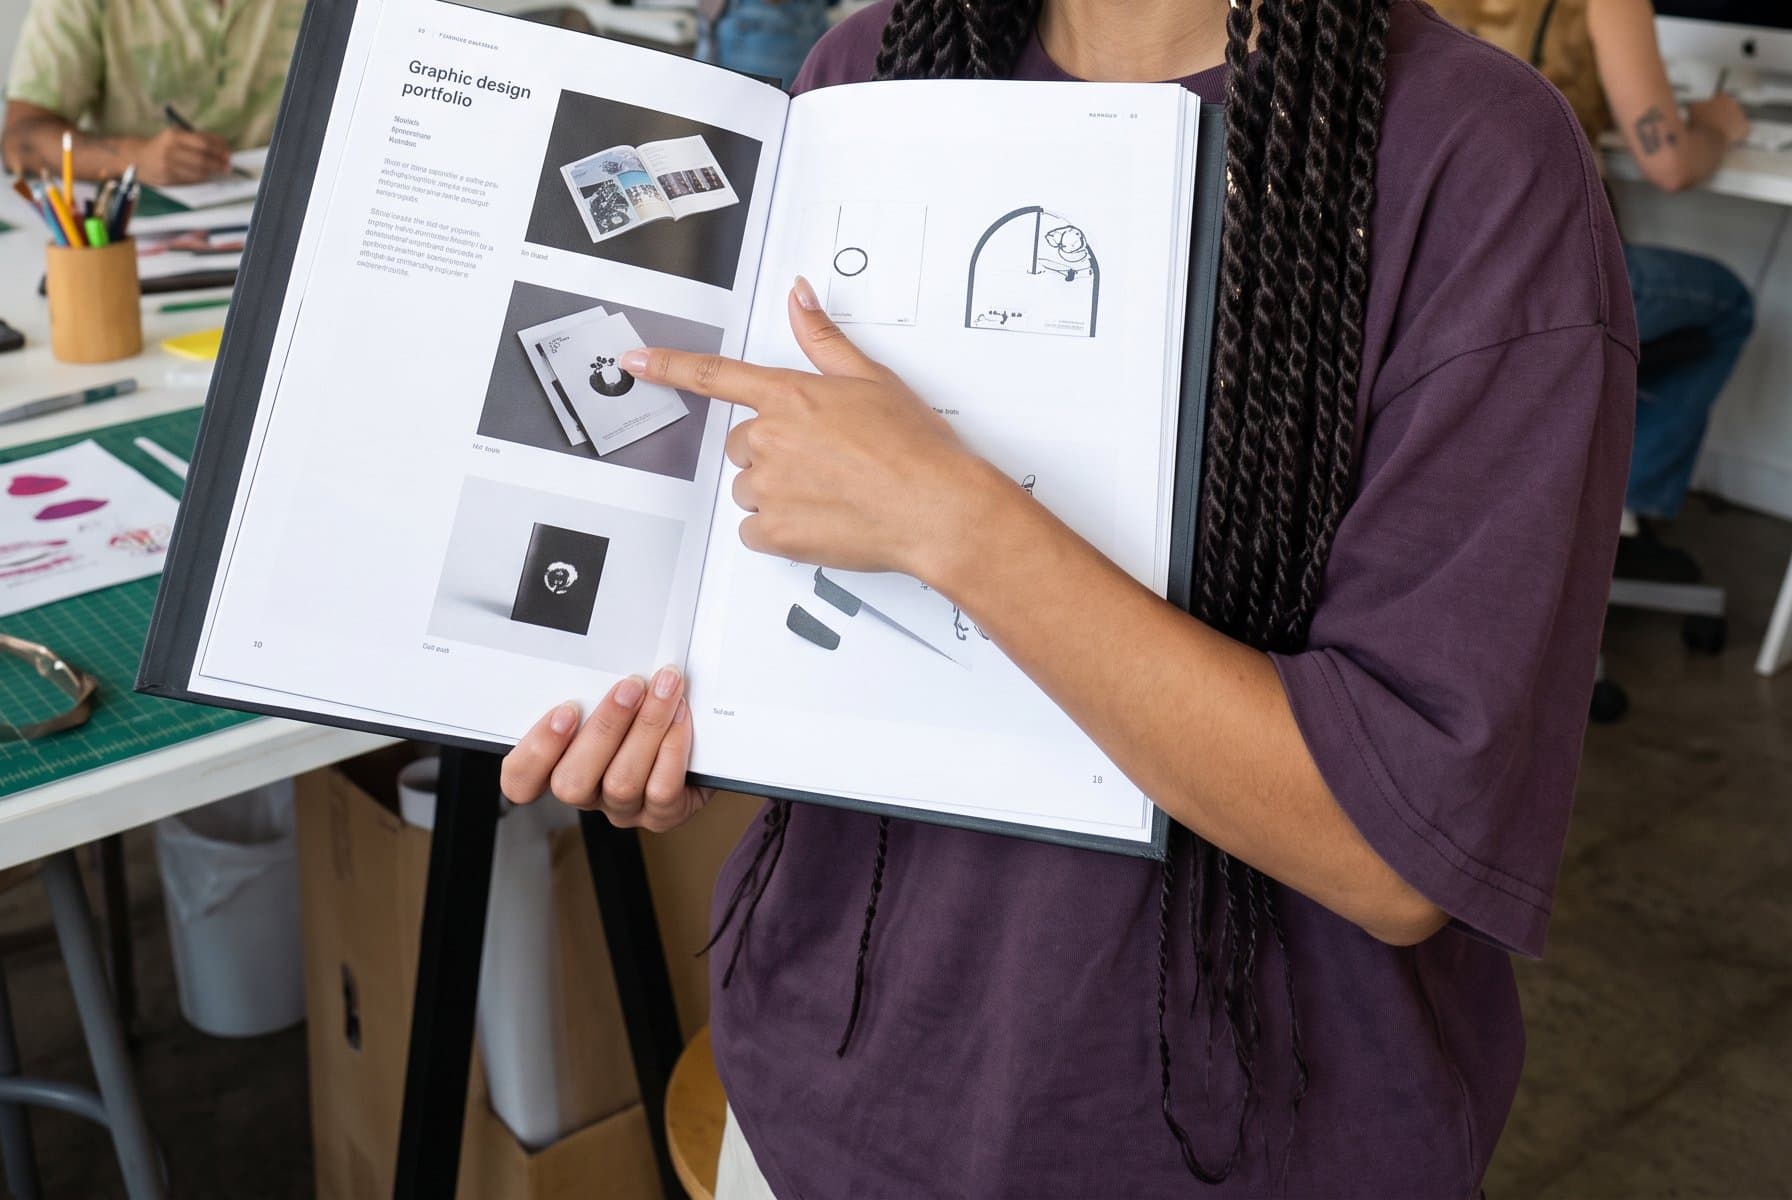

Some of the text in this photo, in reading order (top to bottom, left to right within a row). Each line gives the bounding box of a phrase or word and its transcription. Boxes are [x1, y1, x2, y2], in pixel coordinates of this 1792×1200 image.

[409, 60, 531, 100] Graphic design
[402, 83, 472, 107] portfolio
[253, 640, 263, 649] 10
[1092, 775, 1103, 784] 18
